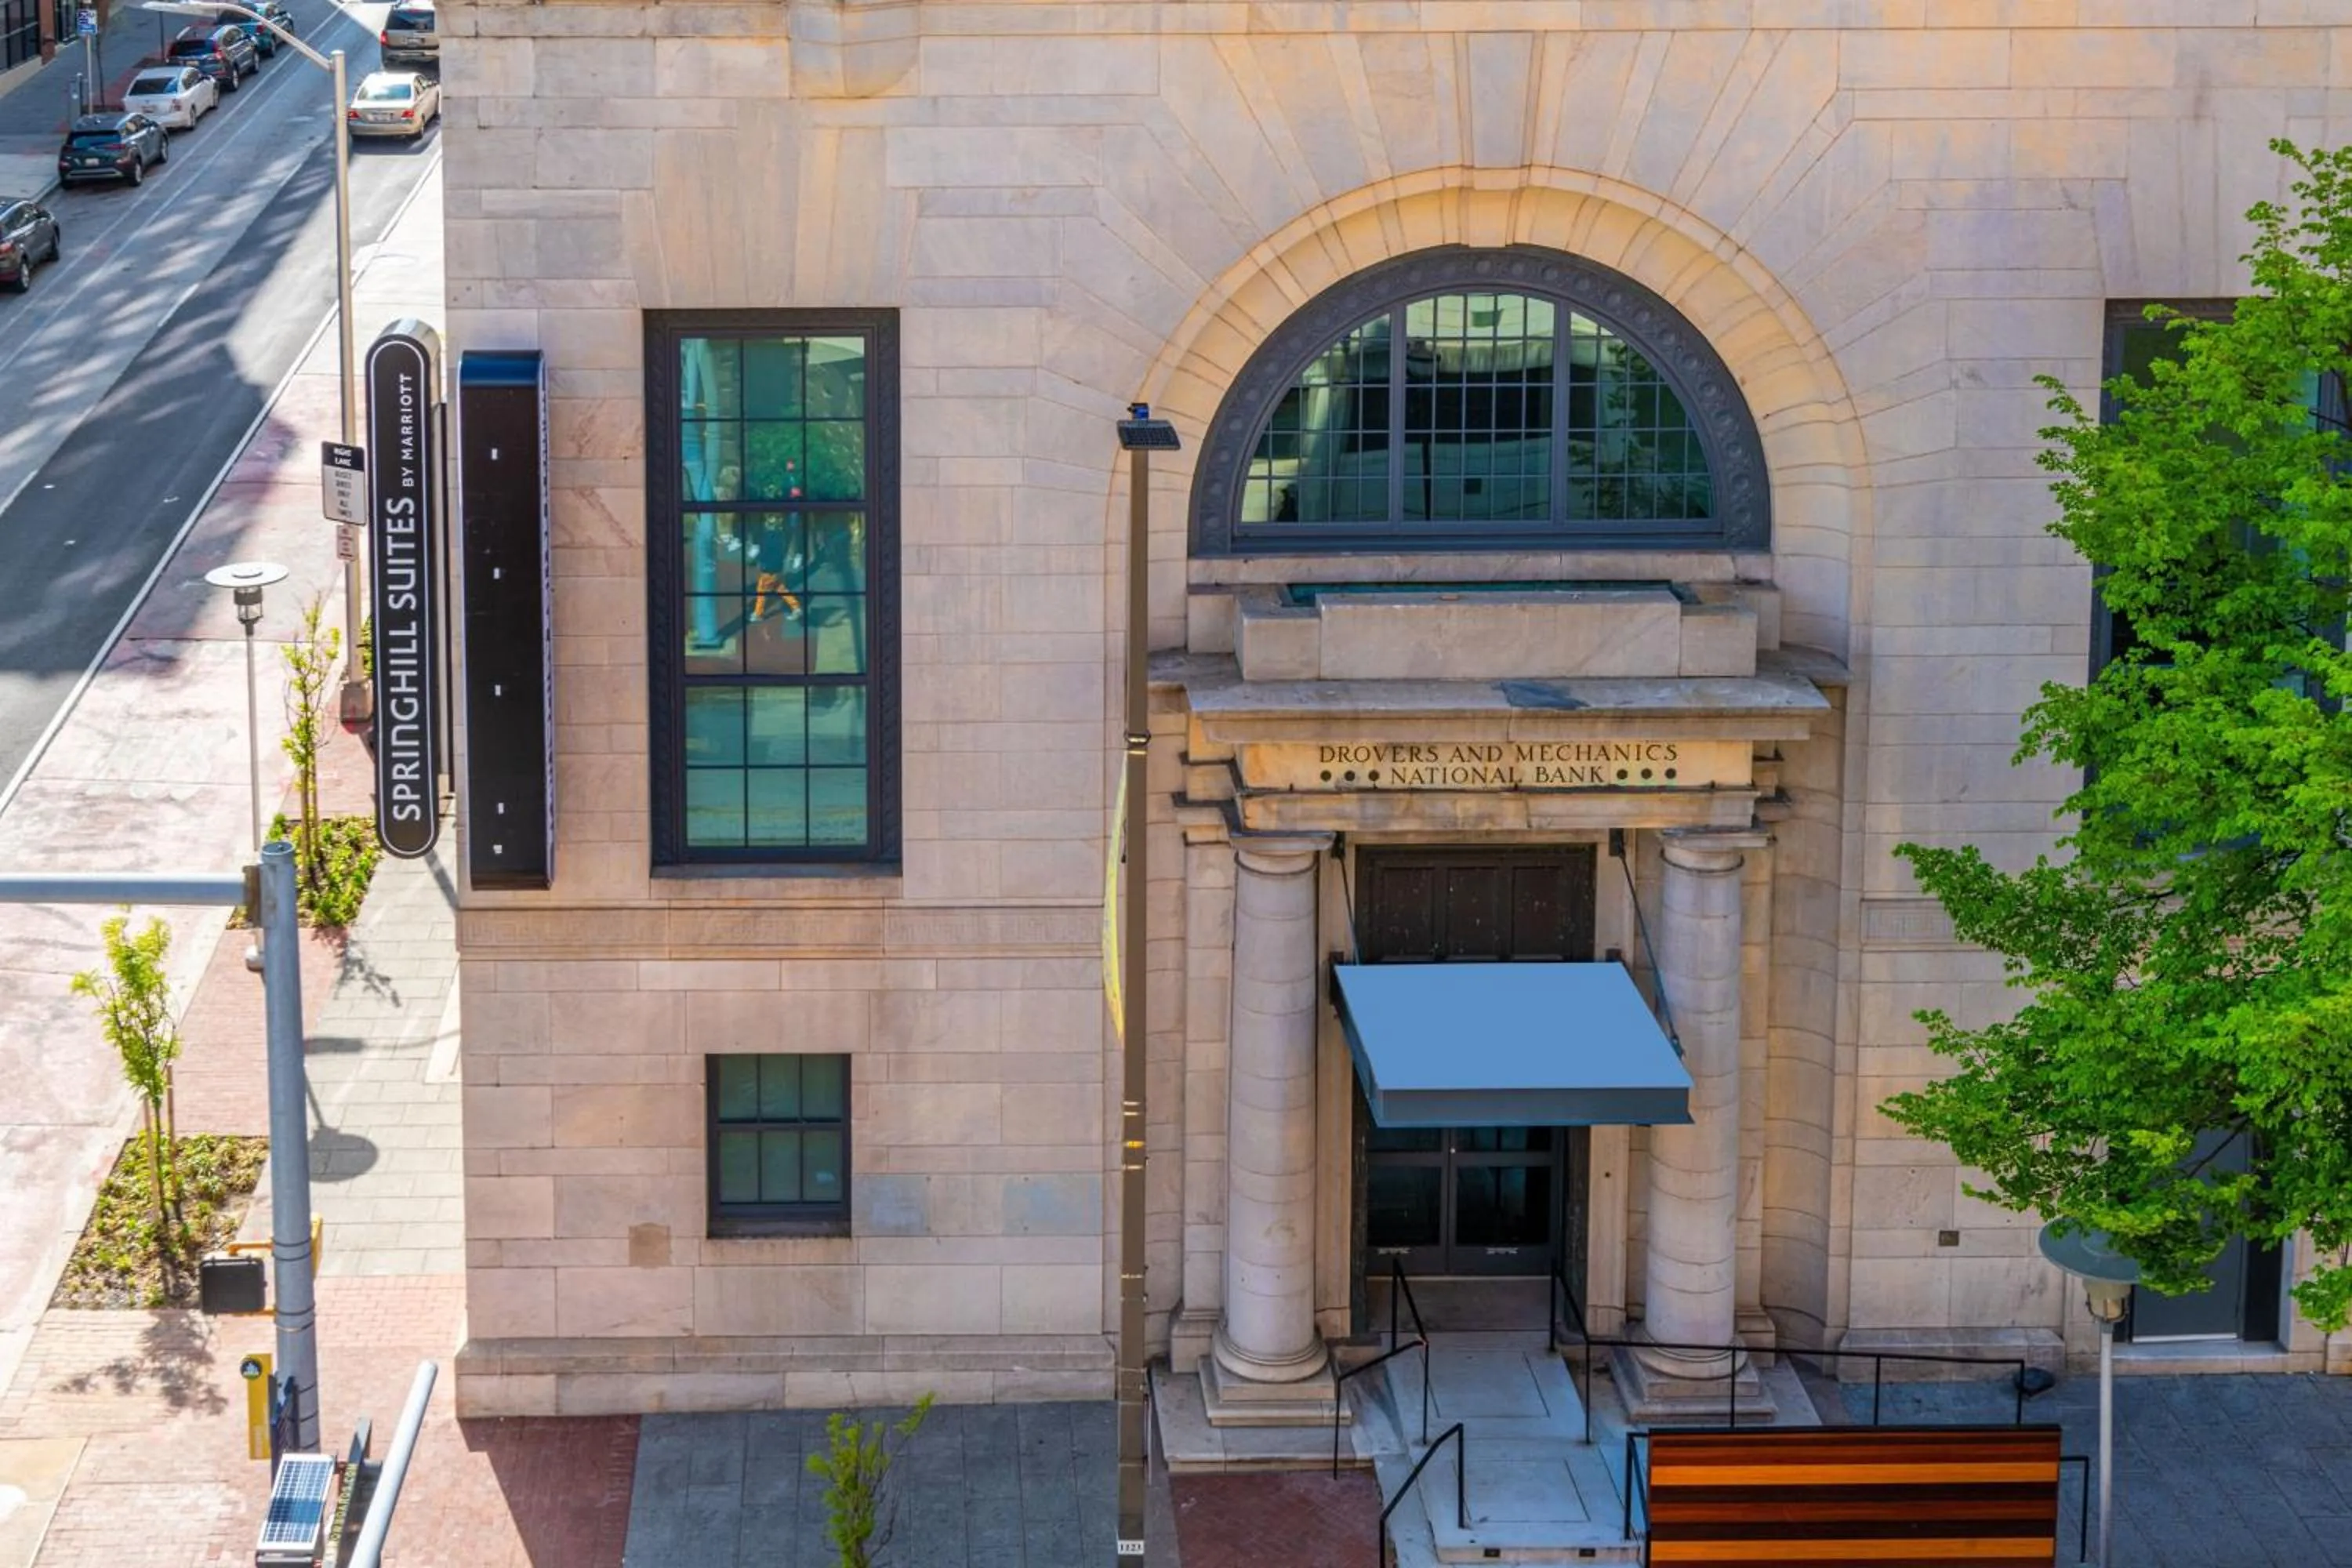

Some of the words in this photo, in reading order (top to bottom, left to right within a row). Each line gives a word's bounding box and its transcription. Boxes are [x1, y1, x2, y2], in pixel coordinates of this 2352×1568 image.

[400, 373, 414, 460] MARRIOTT
[334, 458, 352, 466] LANE
[401, 467, 415, 487] BY
[386, 497, 417, 610] SUITES
[388, 621, 421, 822] SPRINGHILL
[1319, 745, 1438, 764] DROVERS
[1449, 745, 1503, 764] AND
[1515, 743, 1678, 763] MECHANICS
[1391, 765, 1522, 786] NATIONAL
[1535, 765, 1606, 784] BANK
